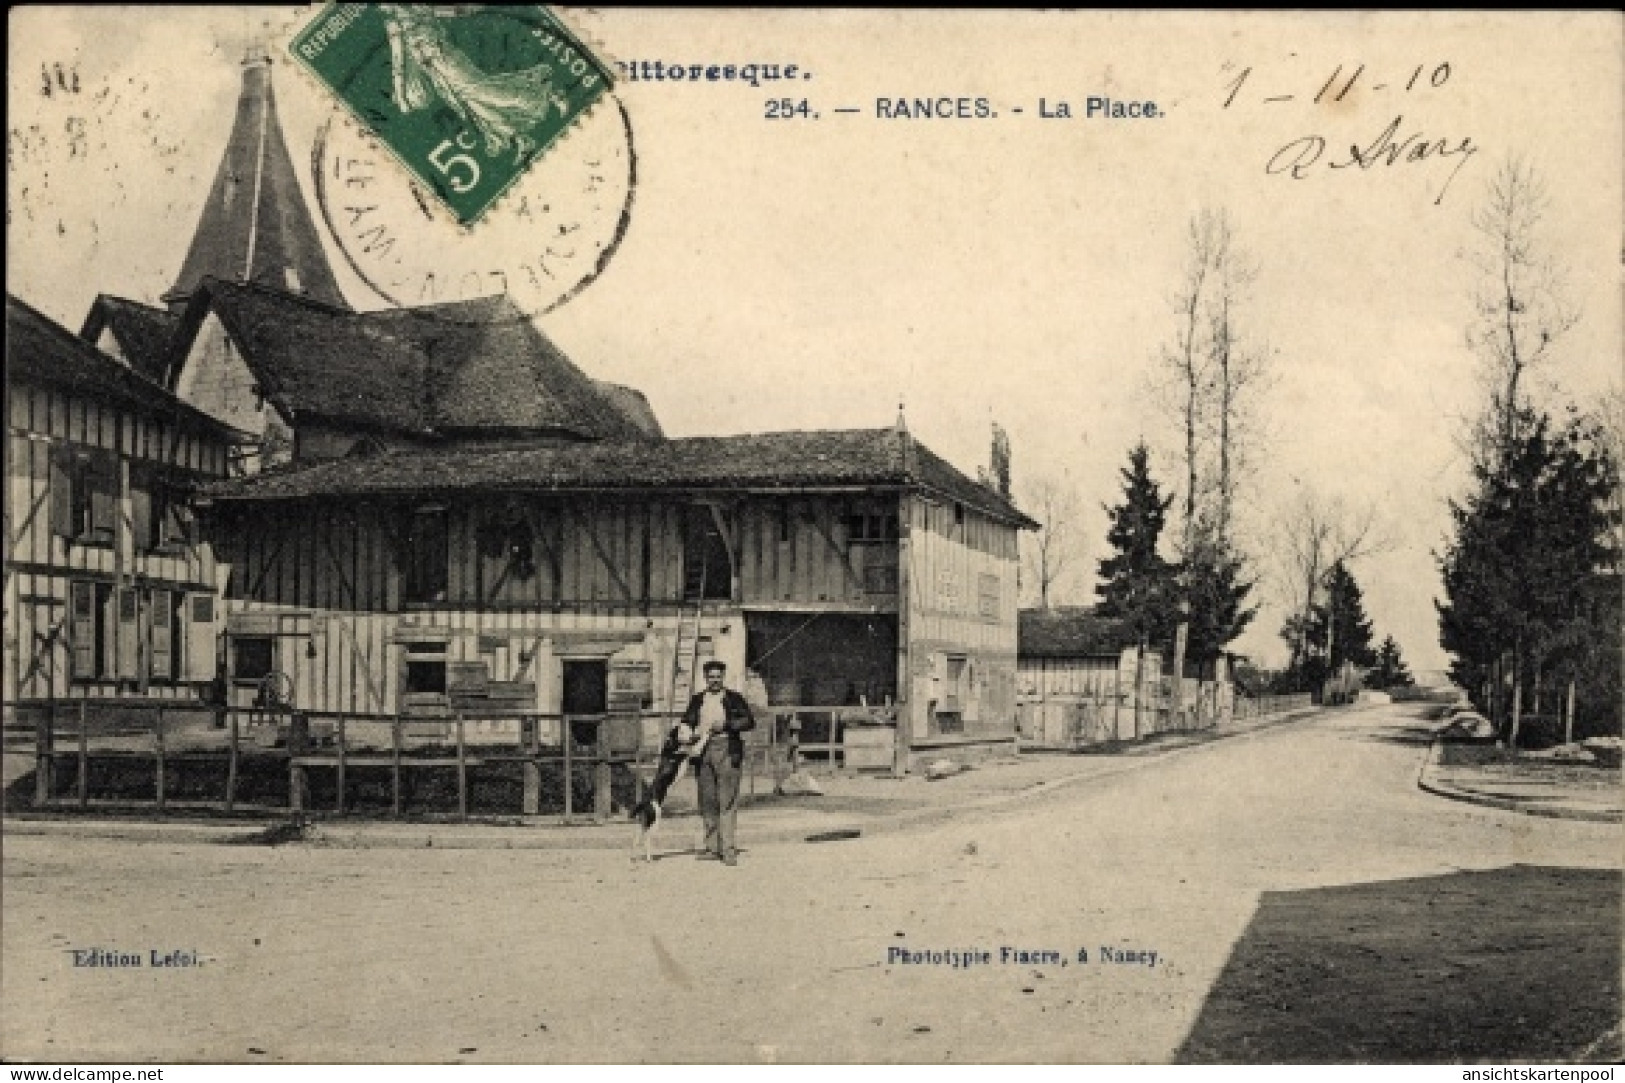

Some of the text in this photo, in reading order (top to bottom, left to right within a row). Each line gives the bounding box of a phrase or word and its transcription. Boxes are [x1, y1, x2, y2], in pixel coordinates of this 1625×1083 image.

[764, 97, 821, 120] 254.
[876, 97, 998, 119] RANCES.
[1038, 97, 1073, 119] La
[1086, 97, 1166, 119] Place.
